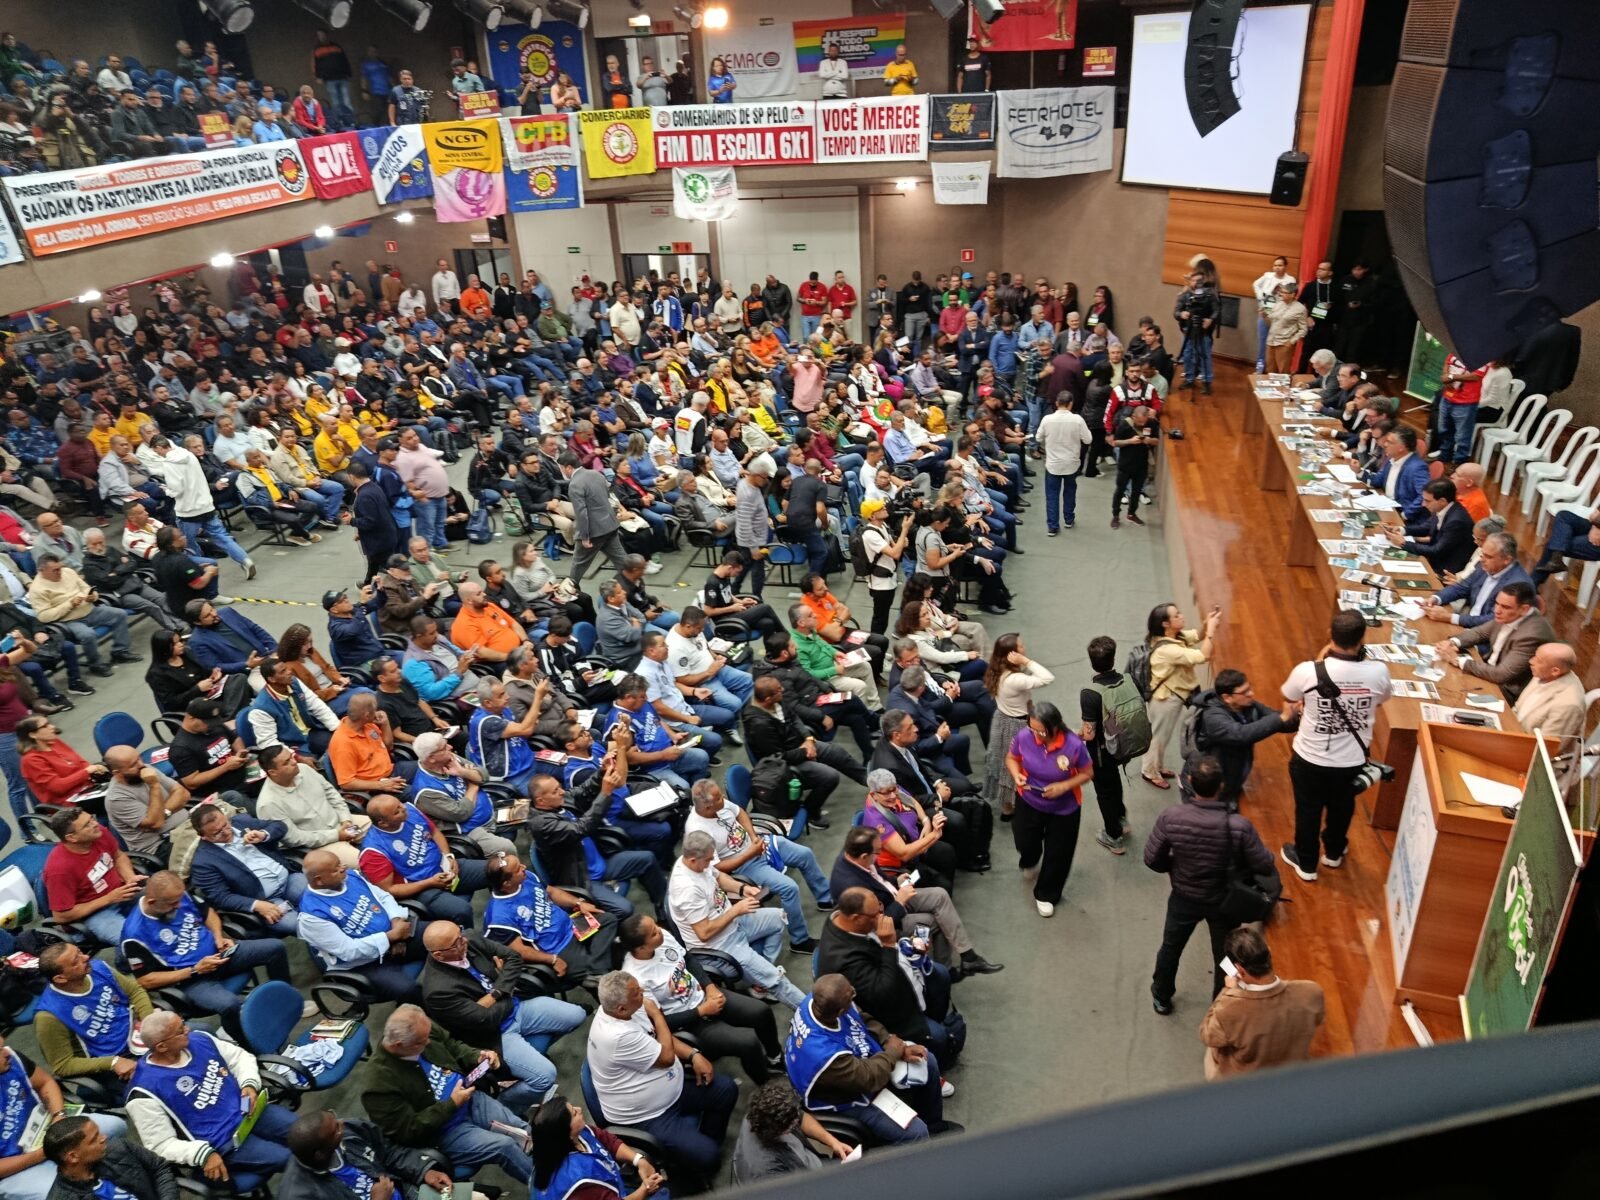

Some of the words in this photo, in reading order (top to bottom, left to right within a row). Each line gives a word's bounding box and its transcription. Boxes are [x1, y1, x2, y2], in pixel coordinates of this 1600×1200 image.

[671, 109, 737, 127] COMERCIÁRIOS
[739, 107, 750, 124] DE
[753, 107, 764, 124] SP
[767, 106, 789, 123] PELO
[822, 102, 858, 132] VOCÊ
[863, 105, 921, 130] MERECE
[1007, 102, 1104, 123] FETRHOTEL
[444, 135, 479, 144] NCST
[516, 121, 567, 145] CTB
[658, 135, 688, 162] FIM
[691, 134, 714, 161] DA
[716, 132, 777, 161] ESCALA
[780, 131, 809, 159] 6X1
[823, 136, 857, 157] TEMPO
[859, 135, 888, 155] PARA
[889, 133, 921, 154] VIVER!
[13, 180, 77, 199] PRESIDENTE
[201, 159, 213, 170] DA
[238, 151, 269, 164] SINDICAL
[312, 143, 354, 179] CUT
[21, 195, 77, 223] SAÚDAM
[77, 197, 94, 213] OS
[98, 180, 176, 211] PARTICIPANTES
[177, 179, 191, 196] DA
[193, 170, 241, 193] AUDIÊNCIA
[239, 164, 276, 185] PÚBLICA
[406, 823, 424, 867] QUÍMICOS
[342, 894, 371, 934] QUÍMICOS
[193, 1059, 220, 1110] QUÍMICOS
